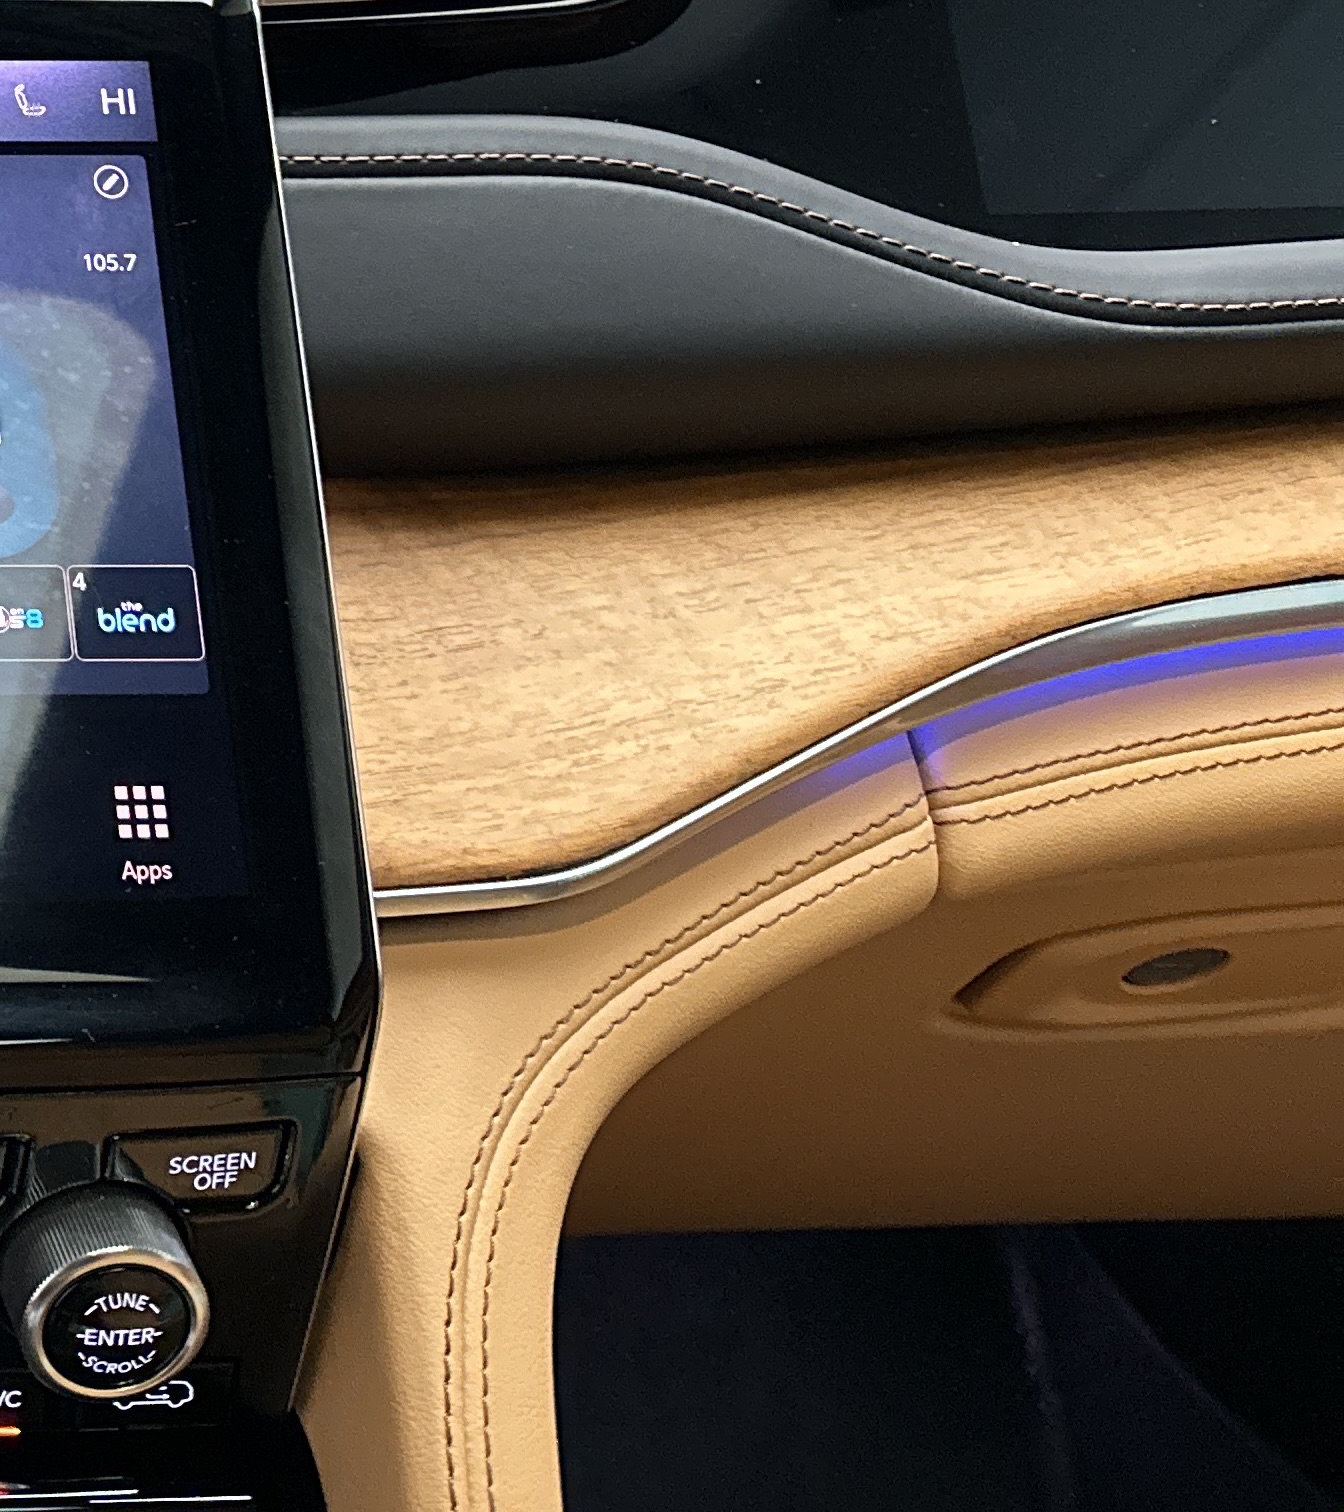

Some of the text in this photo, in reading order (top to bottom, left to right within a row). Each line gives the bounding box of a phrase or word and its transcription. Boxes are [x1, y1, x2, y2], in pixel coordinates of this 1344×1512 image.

[100, 88, 136, 115] HI
[82, 253, 138, 273] 105.7
[73, 572, 87, 591] 4
[120, 601, 143, 612] the
[97, 607, 176, 633] blend
[121, 861, 173, 884] Apps
[169, 1152, 257, 1175] SCREEN
[193, 1171, 238, 1190] OFF
[95, 1293, 151, 1313] TUNE
[83, 1326, 156, 1347] ENTER
[81, 1354, 152, 1376] SCROLL
